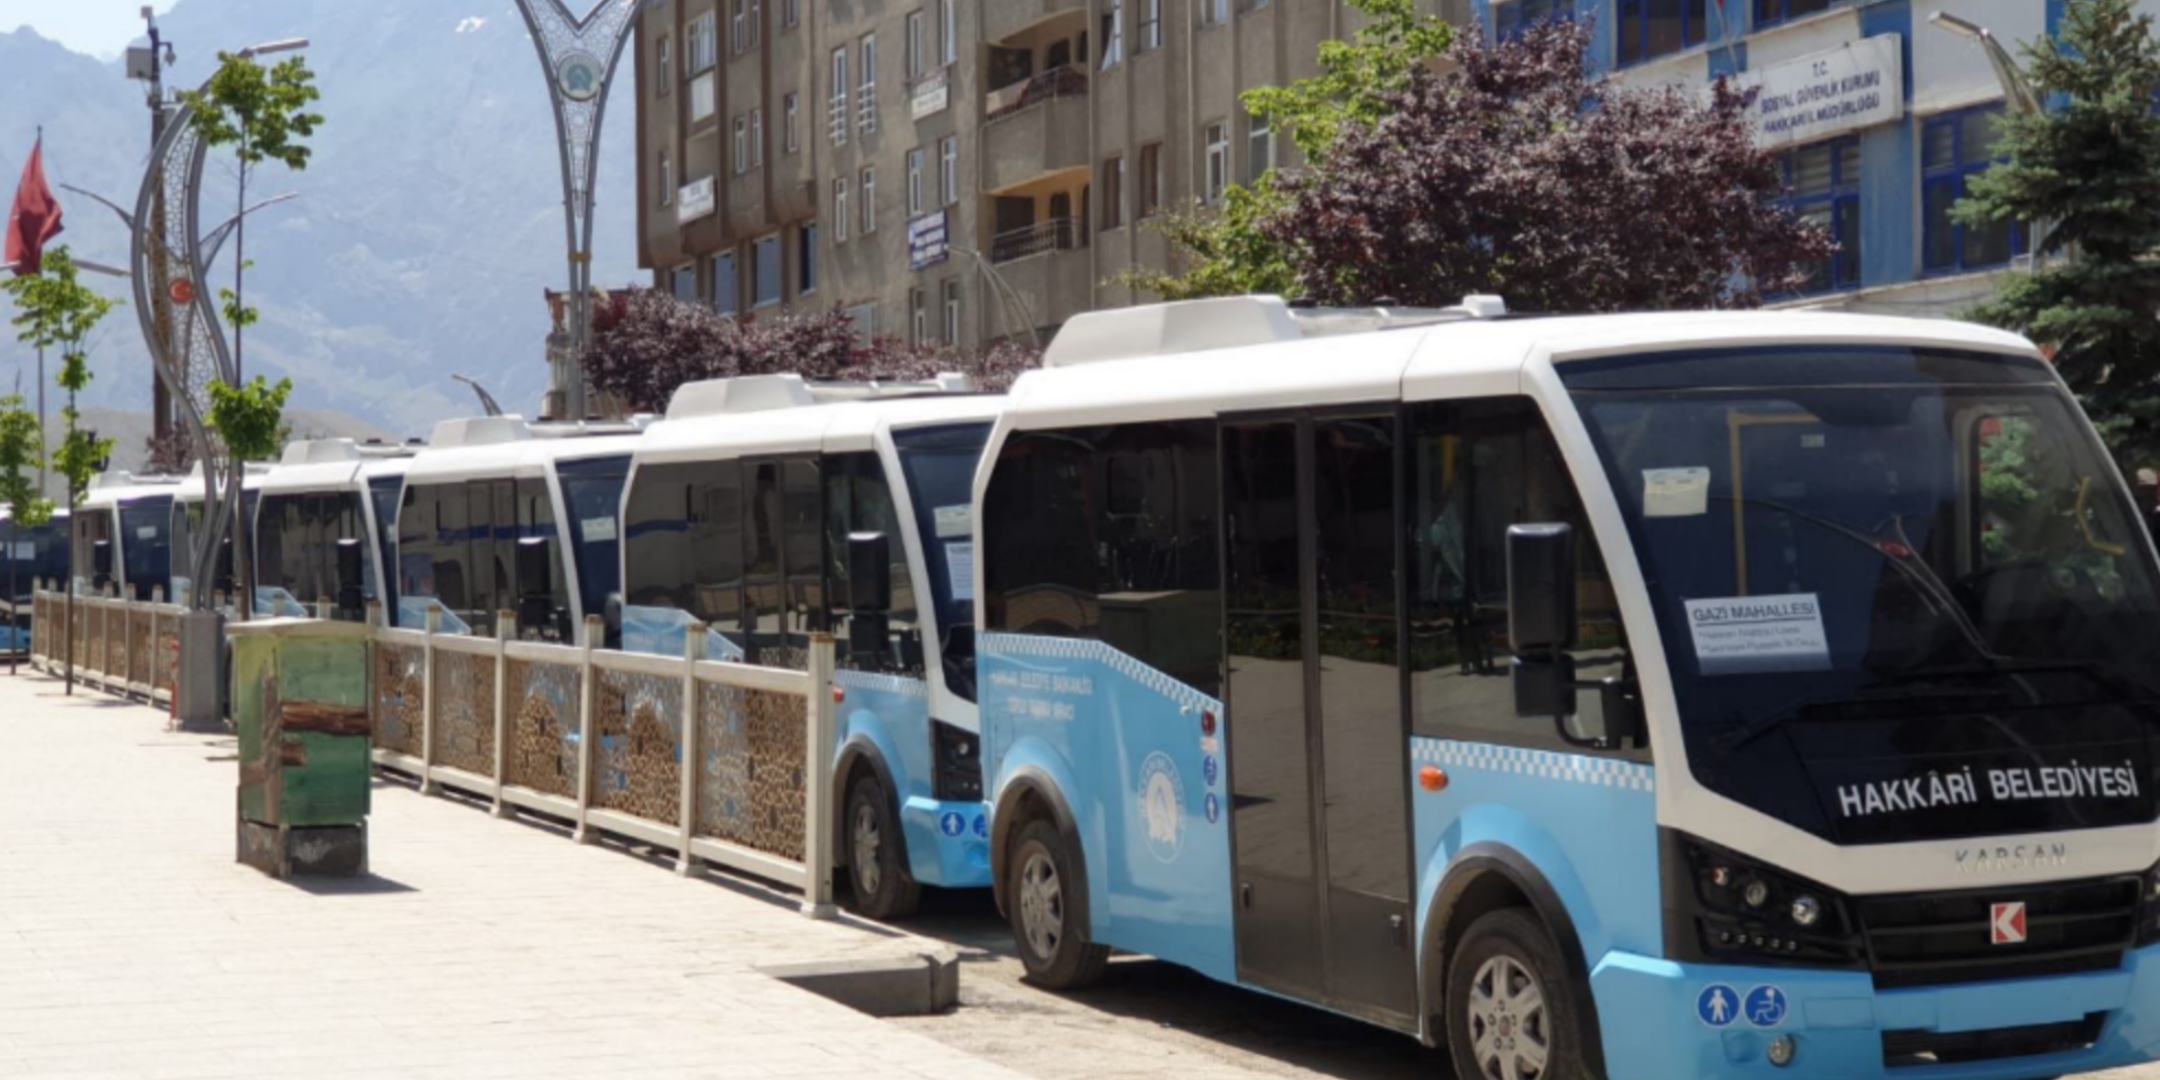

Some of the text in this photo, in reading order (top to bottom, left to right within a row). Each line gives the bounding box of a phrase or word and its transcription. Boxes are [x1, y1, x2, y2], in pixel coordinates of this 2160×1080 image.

[1761, 70, 1880, 114] SOSYAL GÜVENLİK KURUMU
[1838, 760, 2139, 817] HAKKÂRİ BELEDİYESİ
[1955, 843, 2067, 873] KARSAN
